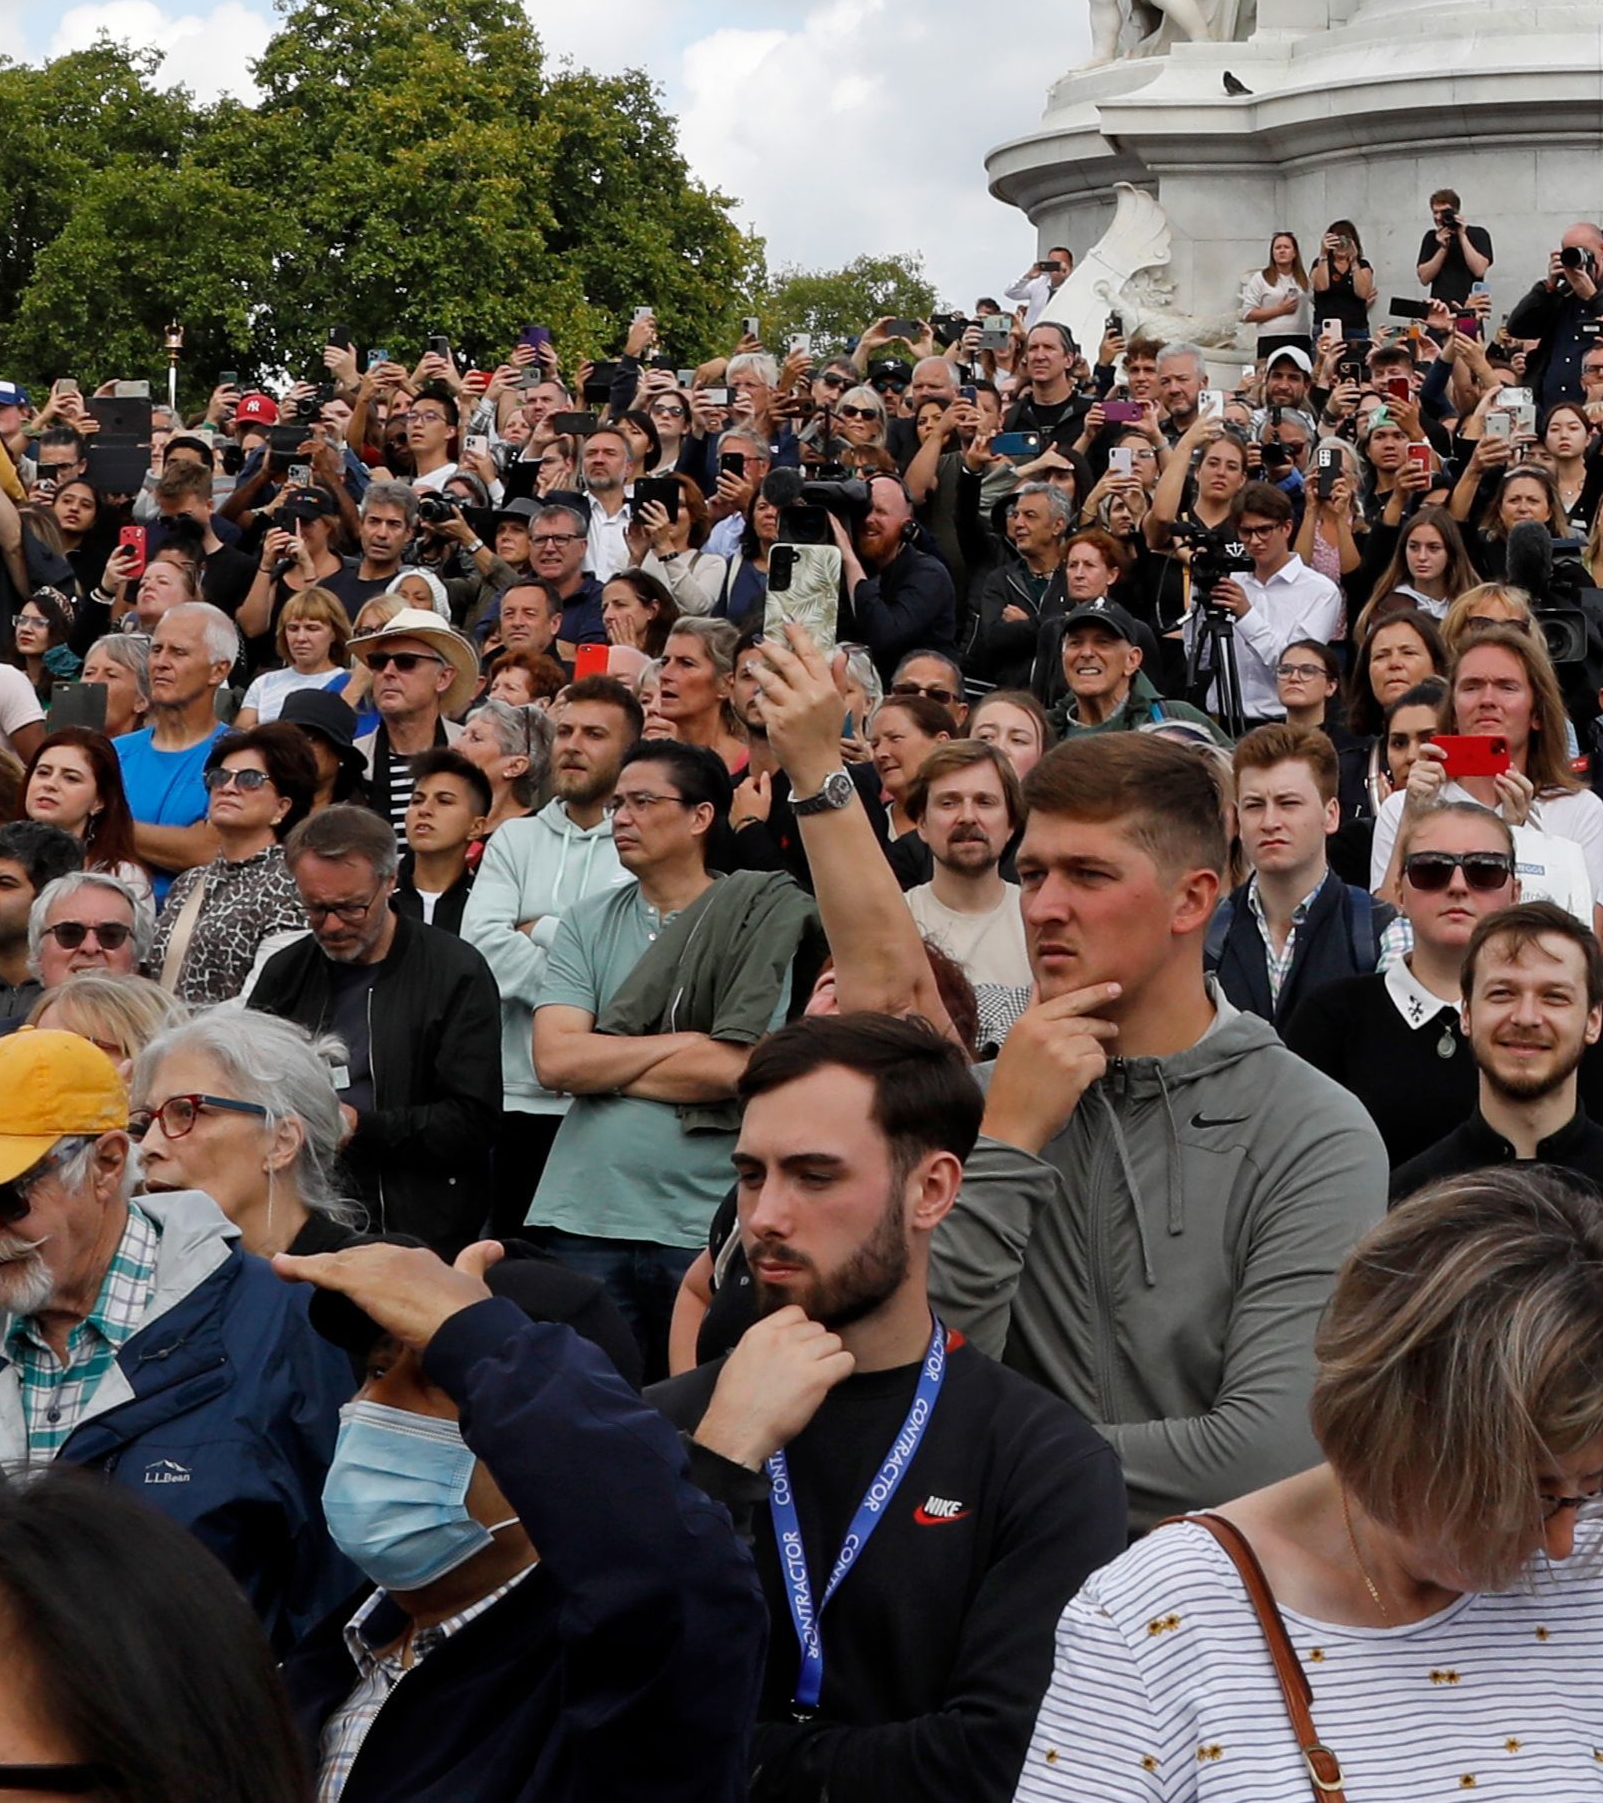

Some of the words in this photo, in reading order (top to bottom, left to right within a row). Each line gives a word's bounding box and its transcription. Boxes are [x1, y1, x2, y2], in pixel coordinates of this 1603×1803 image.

[924, 1323, 945, 1382] ACTOR
[769, 1450, 791, 1506] CONT
[864, 1398, 929, 1513] CONTRACTOR
[924, 1495, 963, 1517] NIKE
[826, 1533, 860, 1592] CONT
